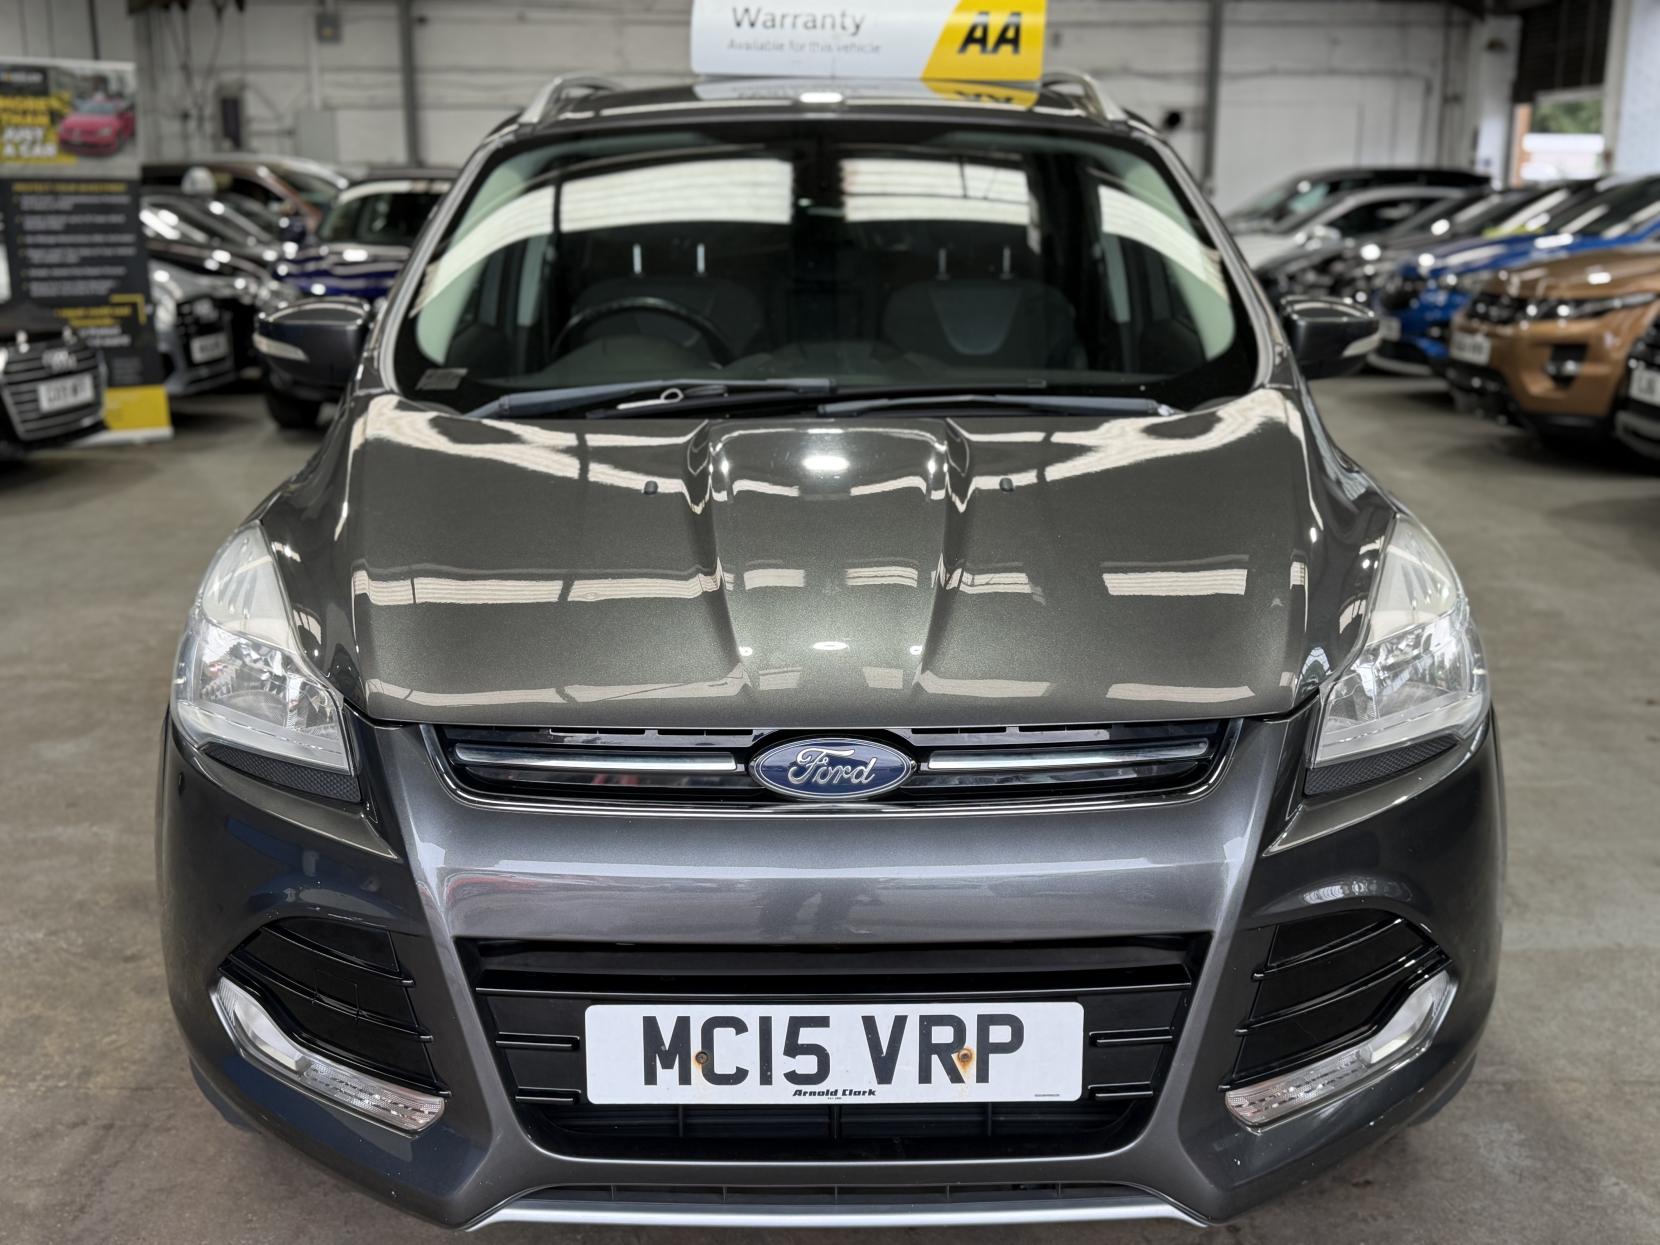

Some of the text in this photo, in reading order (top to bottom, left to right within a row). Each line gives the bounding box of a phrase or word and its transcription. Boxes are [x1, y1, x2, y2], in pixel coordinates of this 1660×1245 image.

[732, 6, 865, 37] Warranty
[958, 11, 1021, 54] AA
[727, 38, 881, 54] Available for this vehicle
[788, 747, 877, 785] Ford
[642, 1013, 1025, 1086] MC15 VRP
[792, 1088, 876, 1097] Arnold Clark
